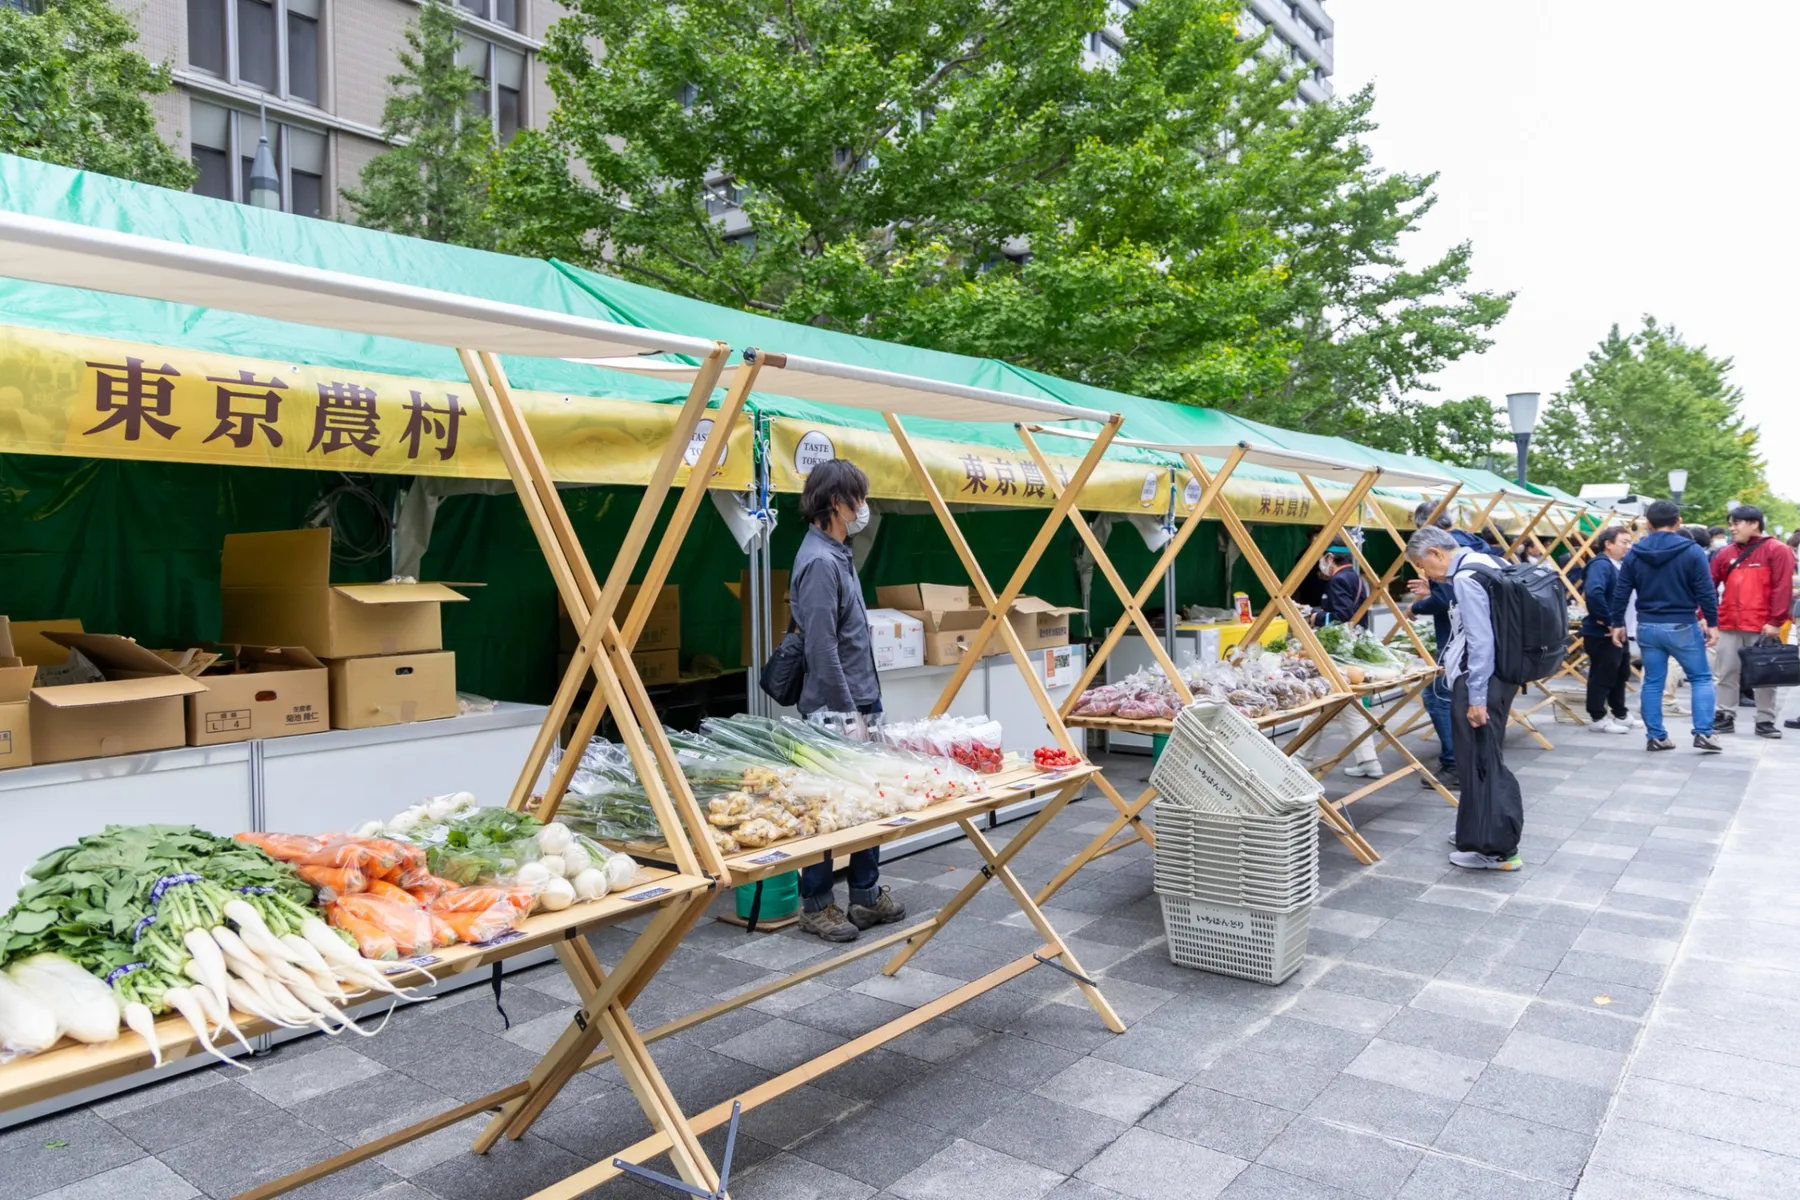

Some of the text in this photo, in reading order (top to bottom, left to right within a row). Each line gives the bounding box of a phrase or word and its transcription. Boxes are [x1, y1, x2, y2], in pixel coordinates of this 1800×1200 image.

[82, 356, 467, 461] 東京農村
[691, 432, 709, 442] TAS
[804, 442, 829, 453] TASTE
[1258, 487, 1310, 518] 東京農村
[212, 722, 219, 730] L
